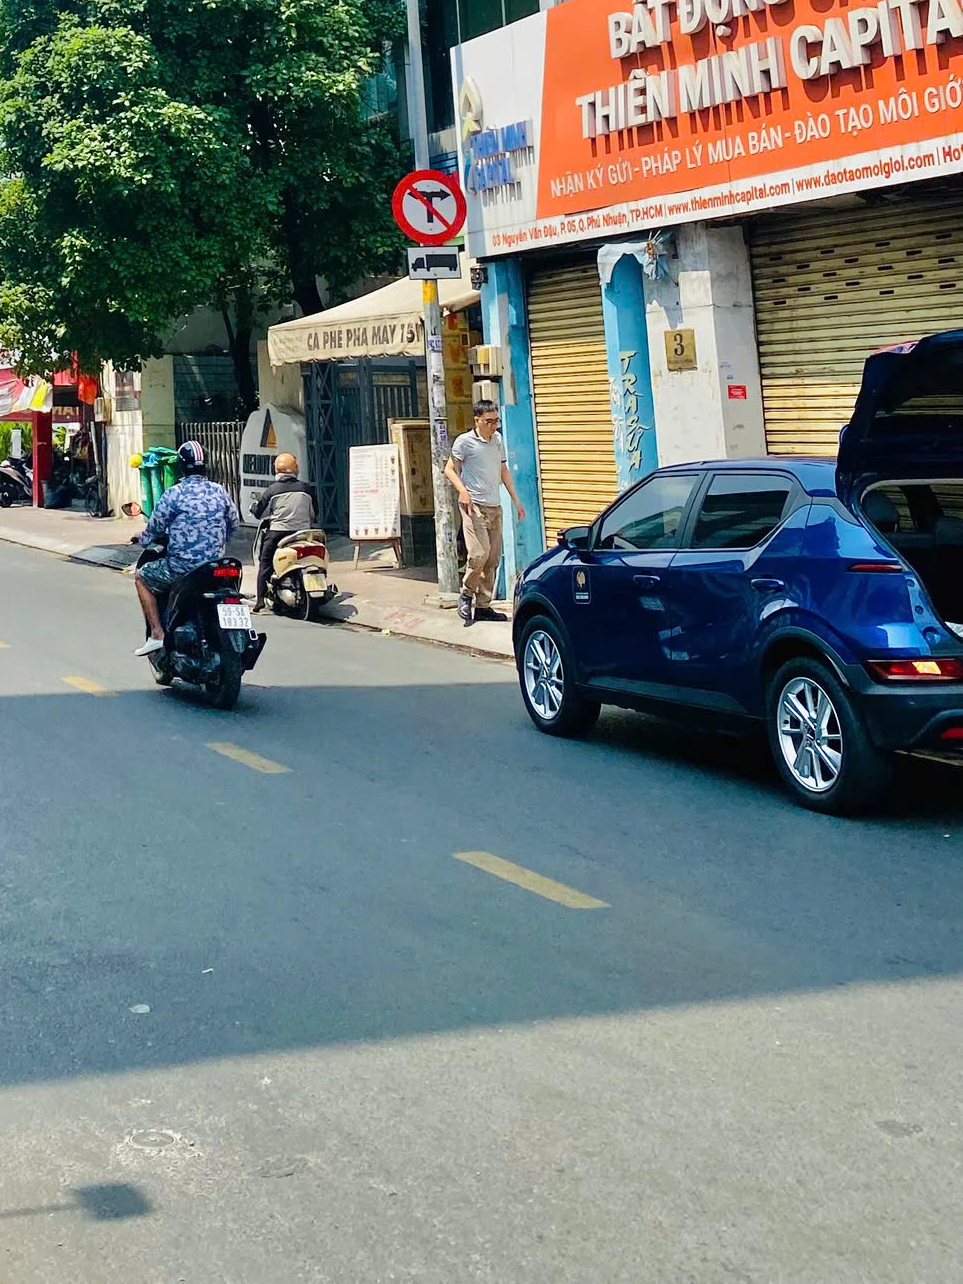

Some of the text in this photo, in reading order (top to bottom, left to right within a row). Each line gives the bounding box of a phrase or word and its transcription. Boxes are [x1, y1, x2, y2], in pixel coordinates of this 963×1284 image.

[550, 74, 963, 200] NHẬN KÝ GỬI PHÁP LÝ MUA BÁN ĐÀO TẠO MÔI GIỚ
[575, 68, 677, 139] THIÊN
[679, 36, 787, 113] MINH
[492, 233, 501, 247] 03
[528, 226, 543, 241] Văn
[587, 215, 601, 231] Phú
[630, 204, 663, 224] TP.HCM
[942, 143, 963, 164] Ho
[673, 333, 685, 356] 3
